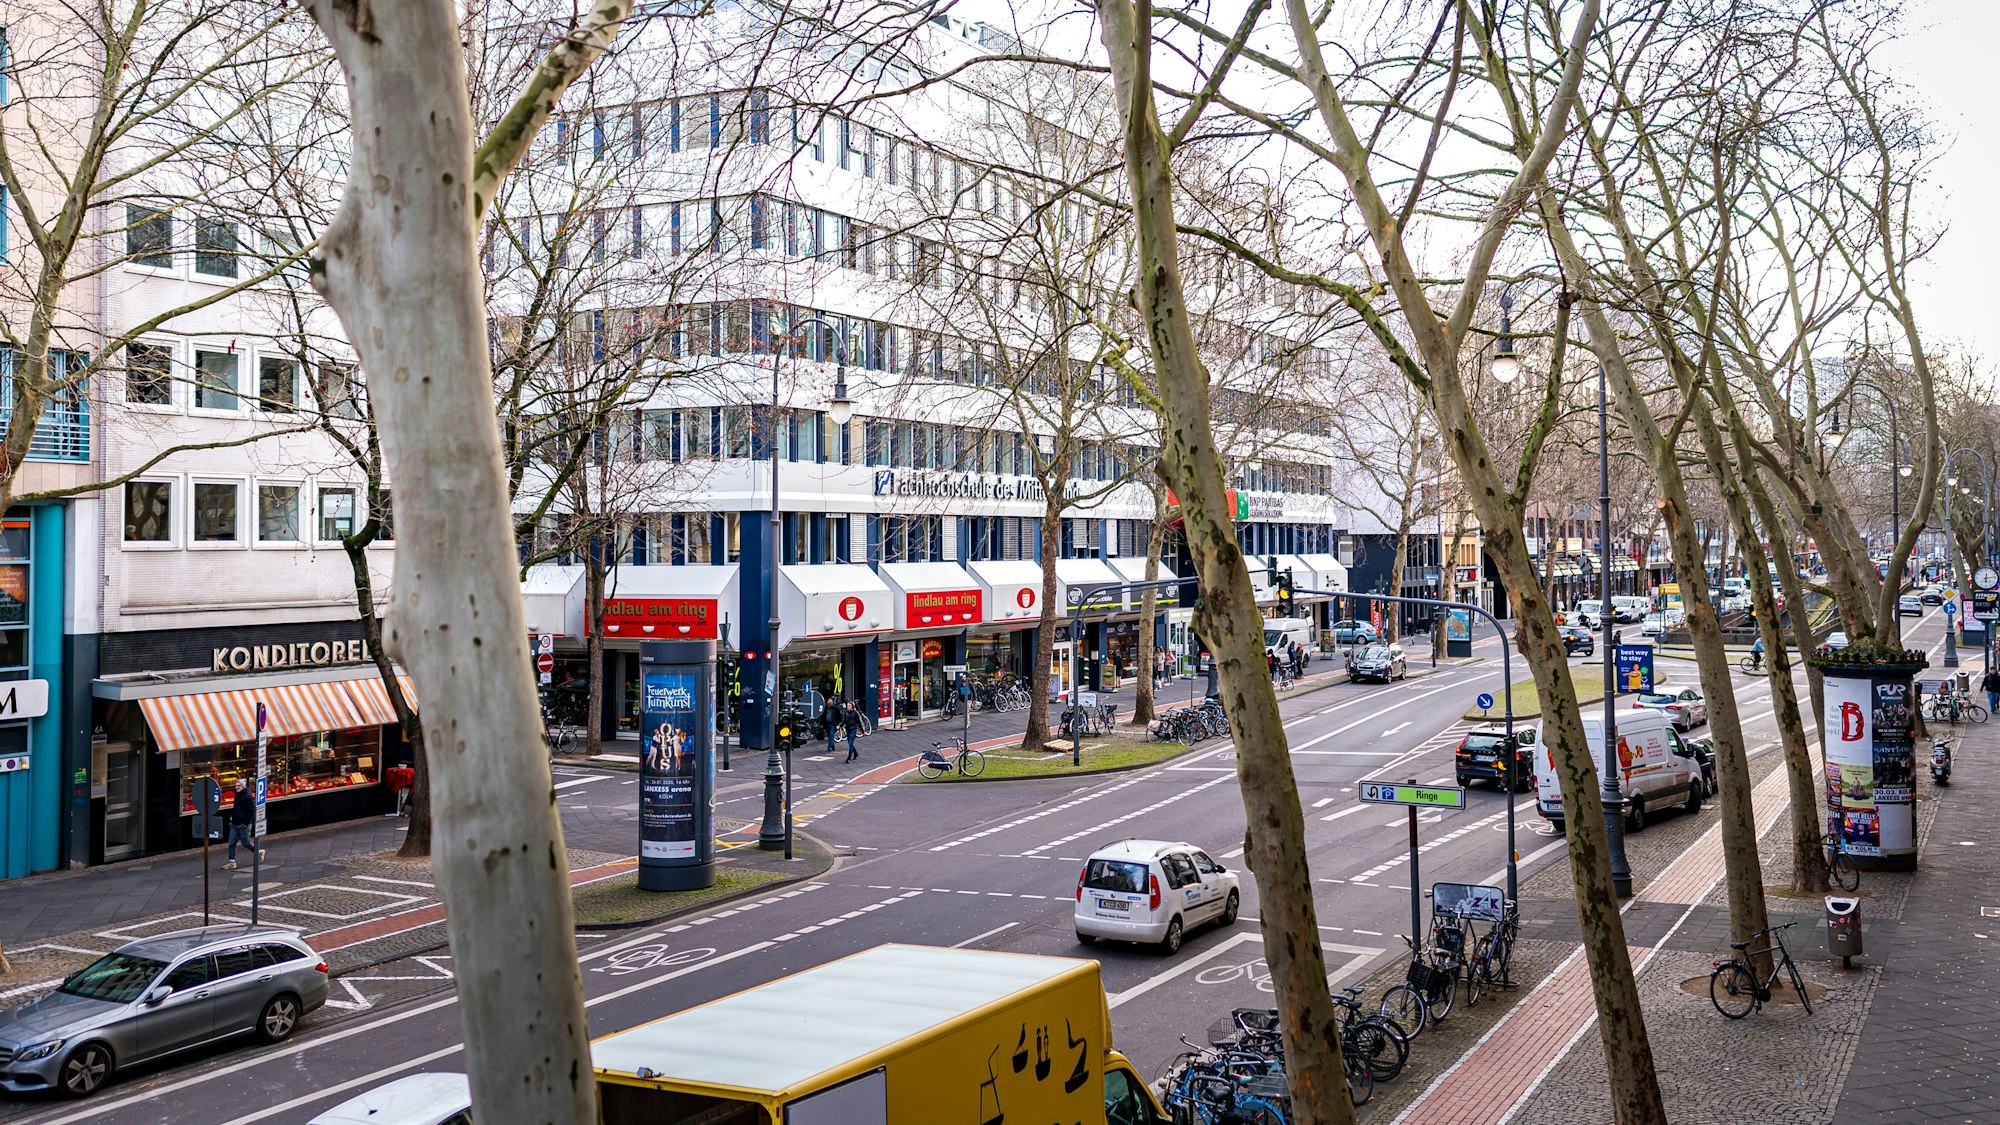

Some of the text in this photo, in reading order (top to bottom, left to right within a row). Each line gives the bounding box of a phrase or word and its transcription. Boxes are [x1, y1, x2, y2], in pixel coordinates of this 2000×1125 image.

[891, 473, 993, 498] Fachhochschule
[995, 478, 1018, 498] des
[1249, 497, 1260, 506] BNP
[913, 592, 977, 608] lindlau am ring
[648, 604, 672, 616] am
[677, 601, 707, 619] ring
[647, 685, 687, 697] Feuerwerk
[1876, 684, 1906, 697] PUR
[1416, 790, 1438, 801] Ringe
